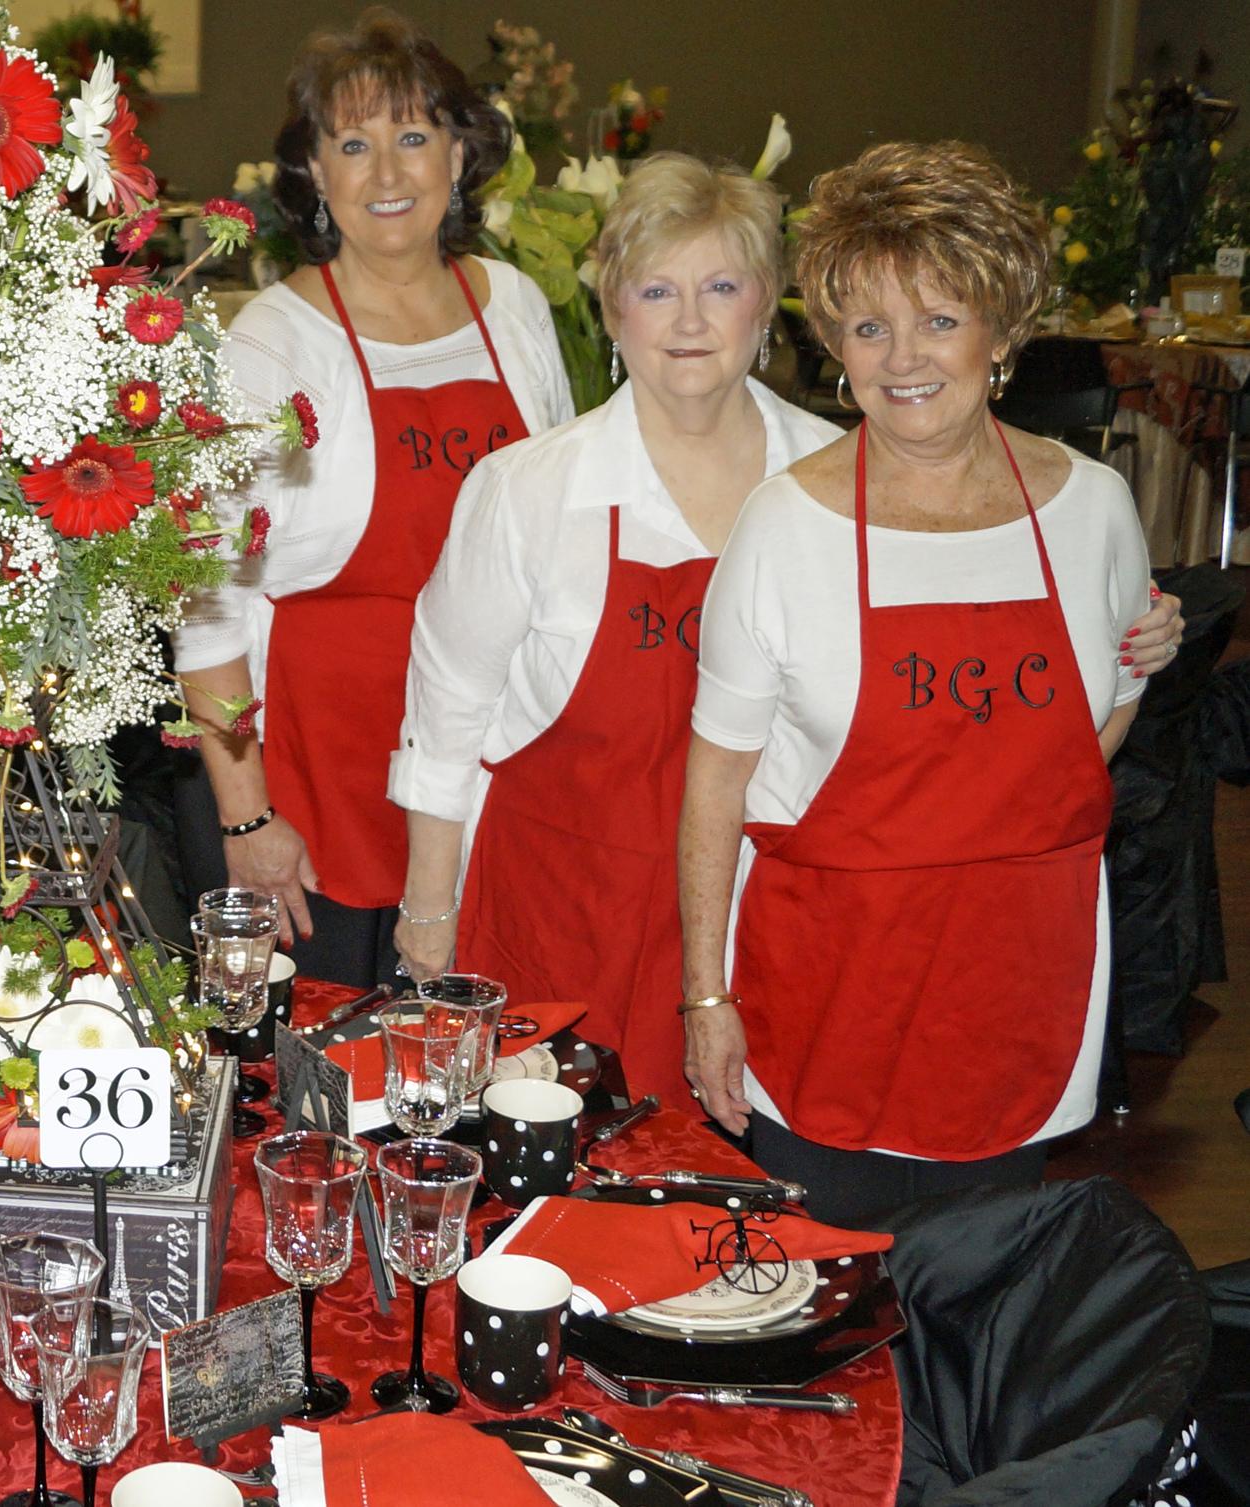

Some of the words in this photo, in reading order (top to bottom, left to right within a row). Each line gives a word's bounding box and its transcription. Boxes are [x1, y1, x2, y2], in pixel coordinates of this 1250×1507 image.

[893, 652, 1054, 724] BGC
[56, 1066, 154, 1130] 36
[146, 1216, 191, 1334] Paris
